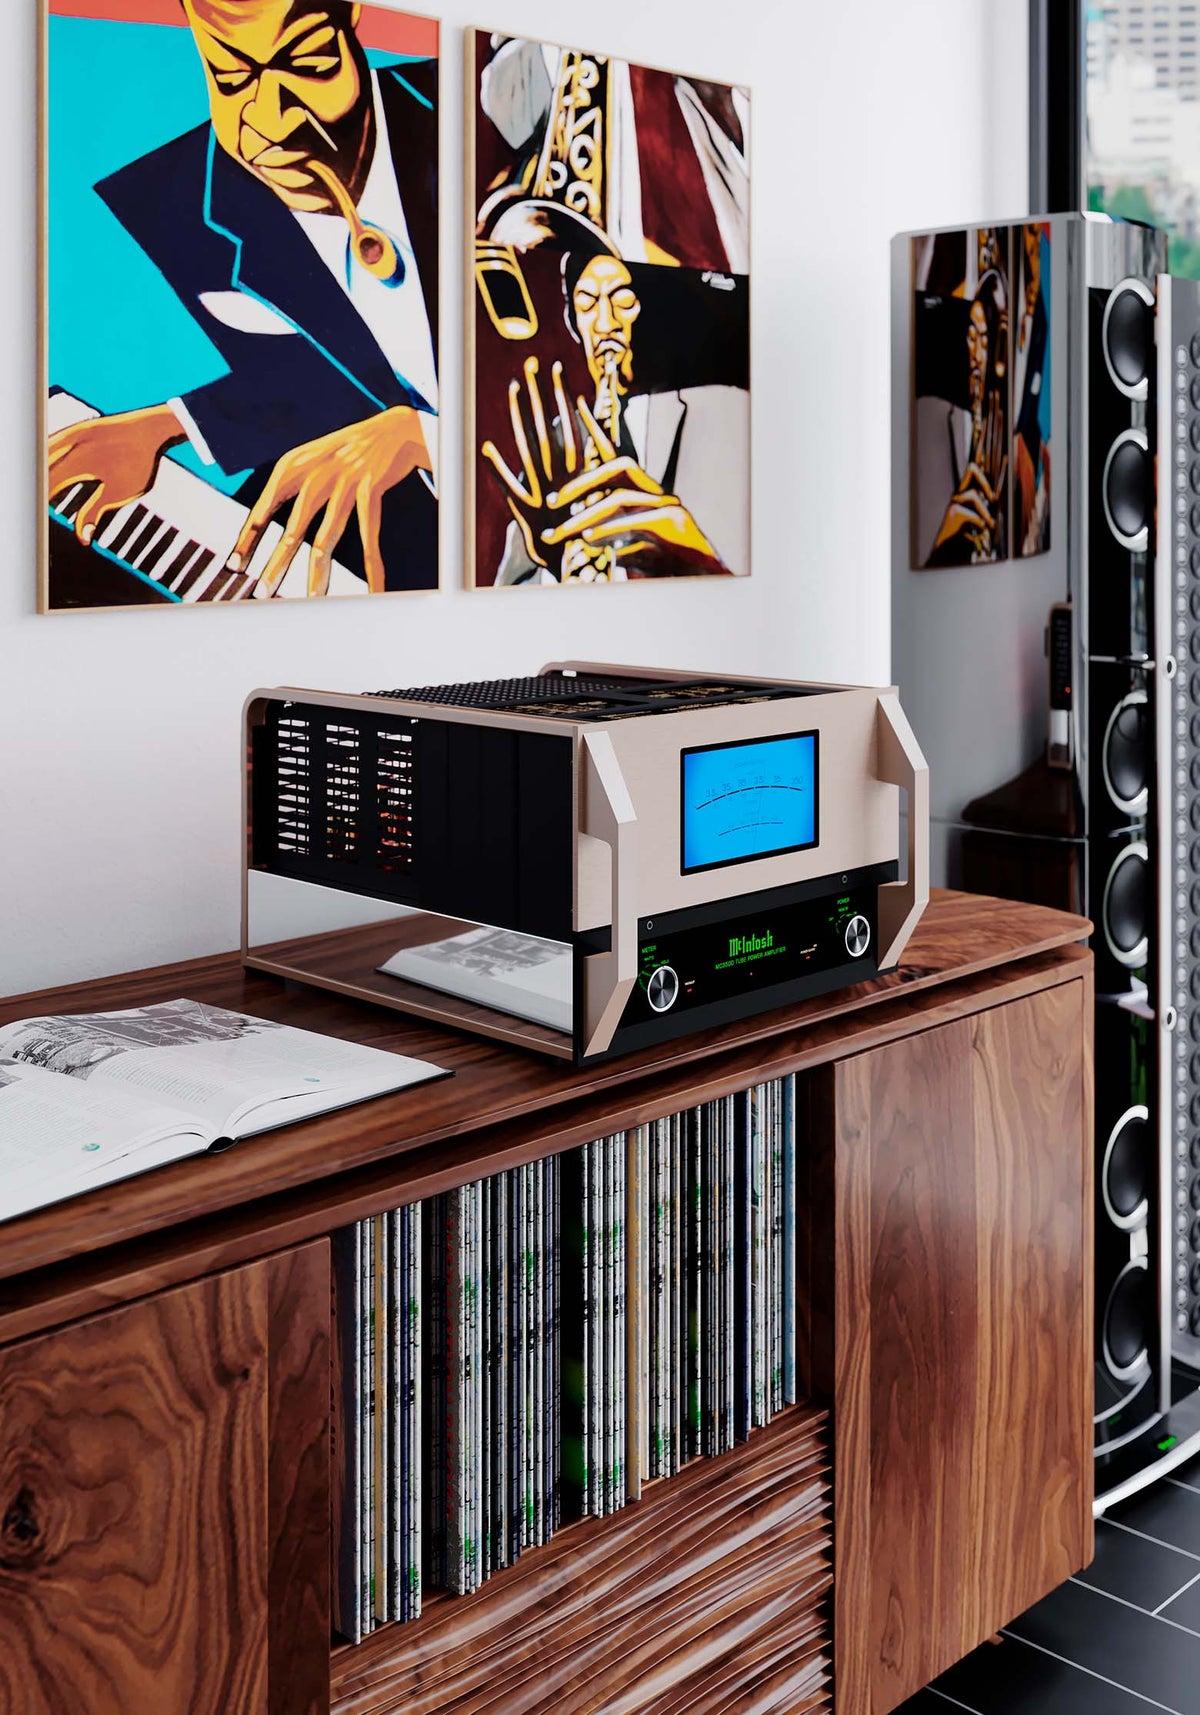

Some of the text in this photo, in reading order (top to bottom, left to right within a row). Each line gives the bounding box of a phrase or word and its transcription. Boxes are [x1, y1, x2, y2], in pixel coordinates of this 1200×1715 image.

[641, 945, 657, 954] METER
[729, 929, 773, 957] McIntosh
[735, 956, 747, 964] TUBE
[747, 951, 763, 961] POWER
[764, 946, 786, 957] AMPLIFIER
